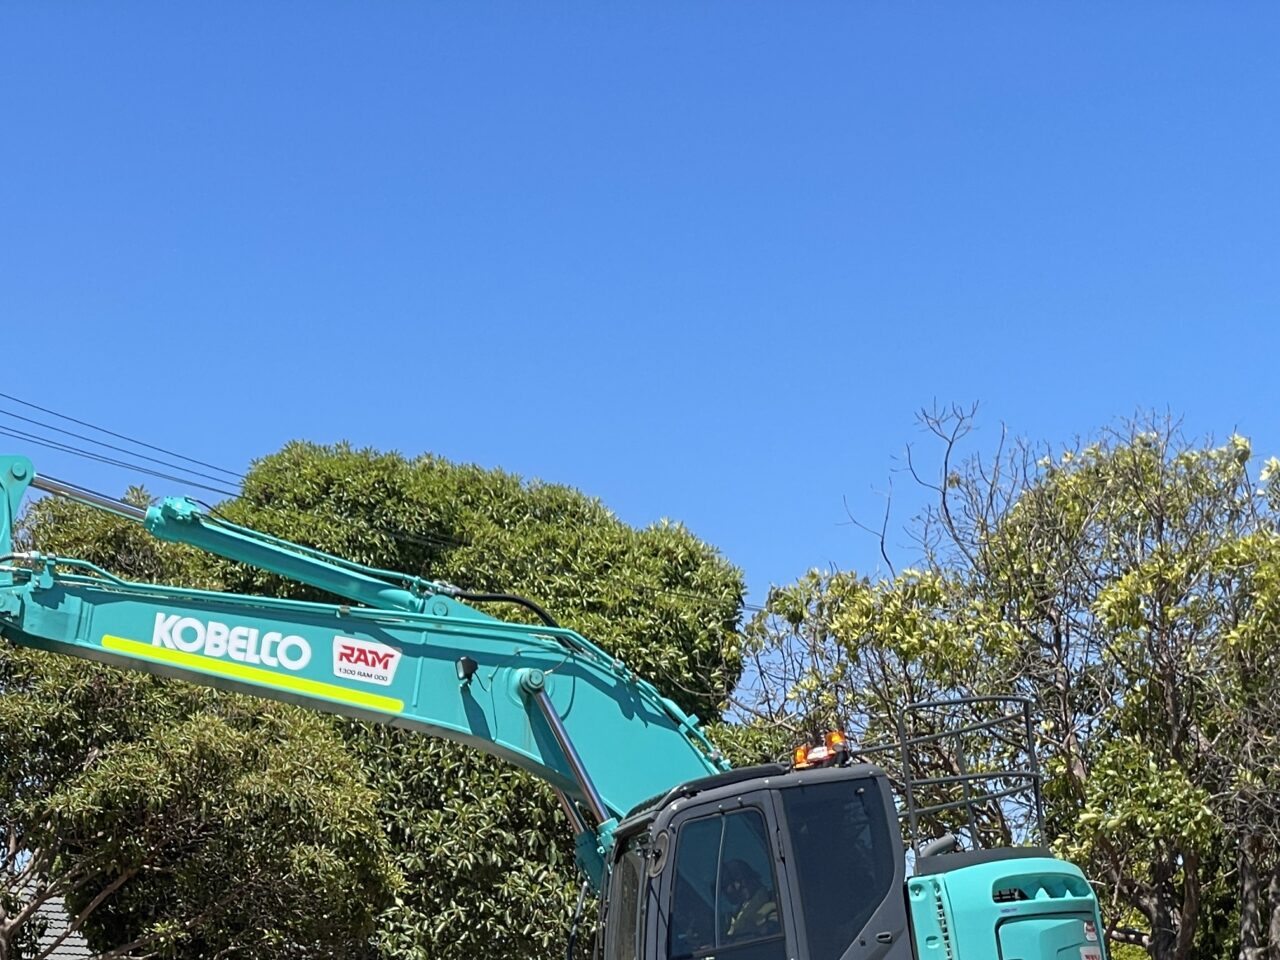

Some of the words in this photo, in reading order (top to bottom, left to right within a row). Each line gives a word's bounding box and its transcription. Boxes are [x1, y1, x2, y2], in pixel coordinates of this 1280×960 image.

[152, 612, 312, 672] KOBELCO
[338, 645, 395, 670] RAM
[339, 667, 356, 676] 1300
[357, 670, 373, 679] RAM
[374, 674, 388, 682] 000
